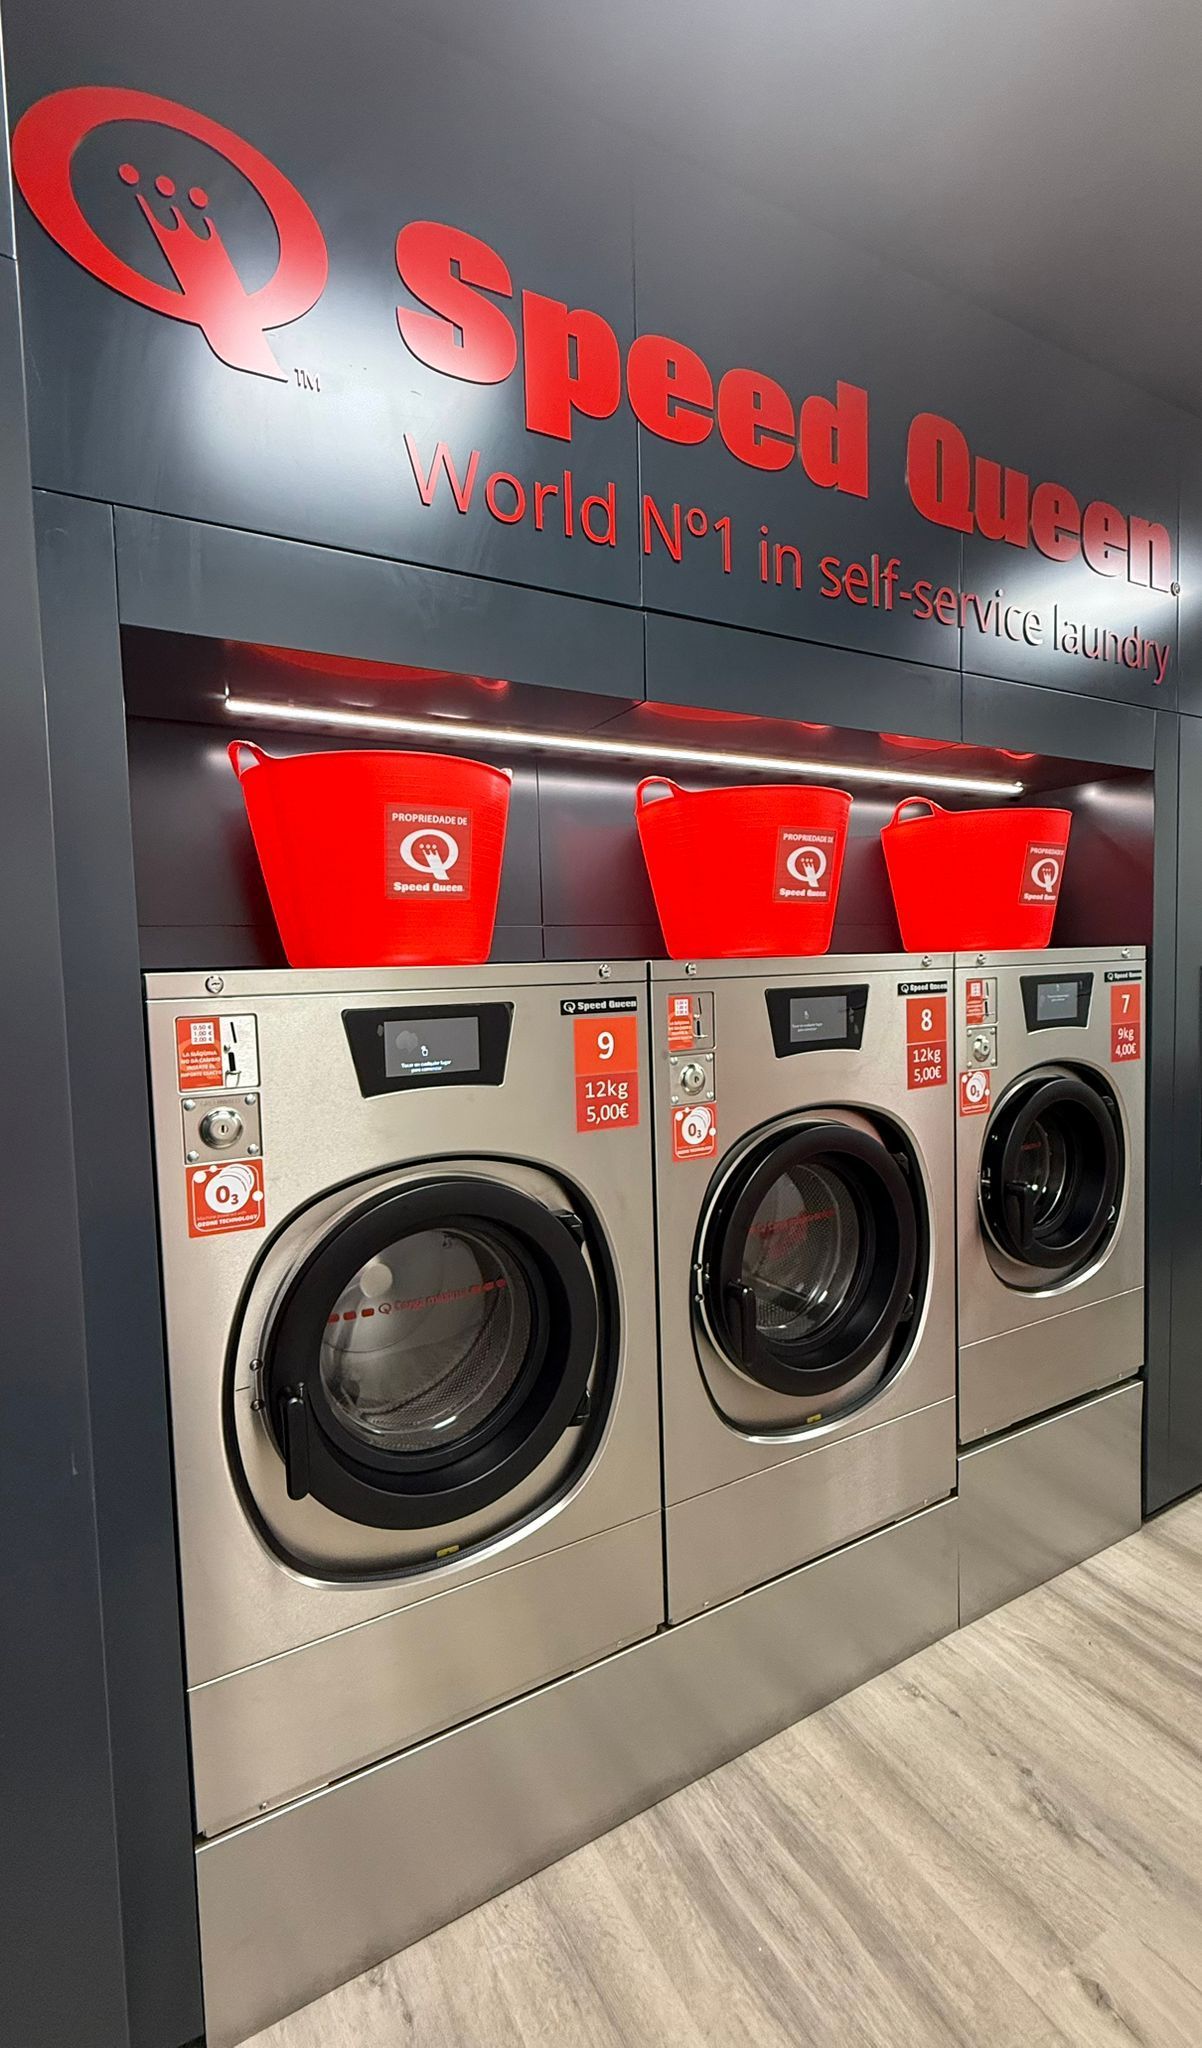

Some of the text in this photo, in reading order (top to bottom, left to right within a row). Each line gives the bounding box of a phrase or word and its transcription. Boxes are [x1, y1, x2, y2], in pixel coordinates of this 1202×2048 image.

[395, 220, 869, 499] Speed
[403, 432, 616, 547] World
[758, 525, 803, 590] in
[820, 553, 1044, 647] self-service
[1053, 603, 1170, 685] laundry
[392, 812, 468, 825] PROPRIEDADE DE
[393, 881, 464, 893] Speed Queen
[578, 1001, 606, 1011] Speed
[609, 1000, 637, 1008] Queen
[1121, 994, 1130, 1013] 7
[921, 1008, 932, 1031] 8
[1118, 1027, 1134, 1041] 9kg
[597, 1031, 615, 1060] 9
[1115, 1043, 1137, 1057] 4,00€
[913, 1047, 941, 1063] 12kg
[914, 1066, 942, 1083] 5,00€
[585, 1080, 629, 1100] 12kg
[586, 1103, 629, 1124] 5,00€
